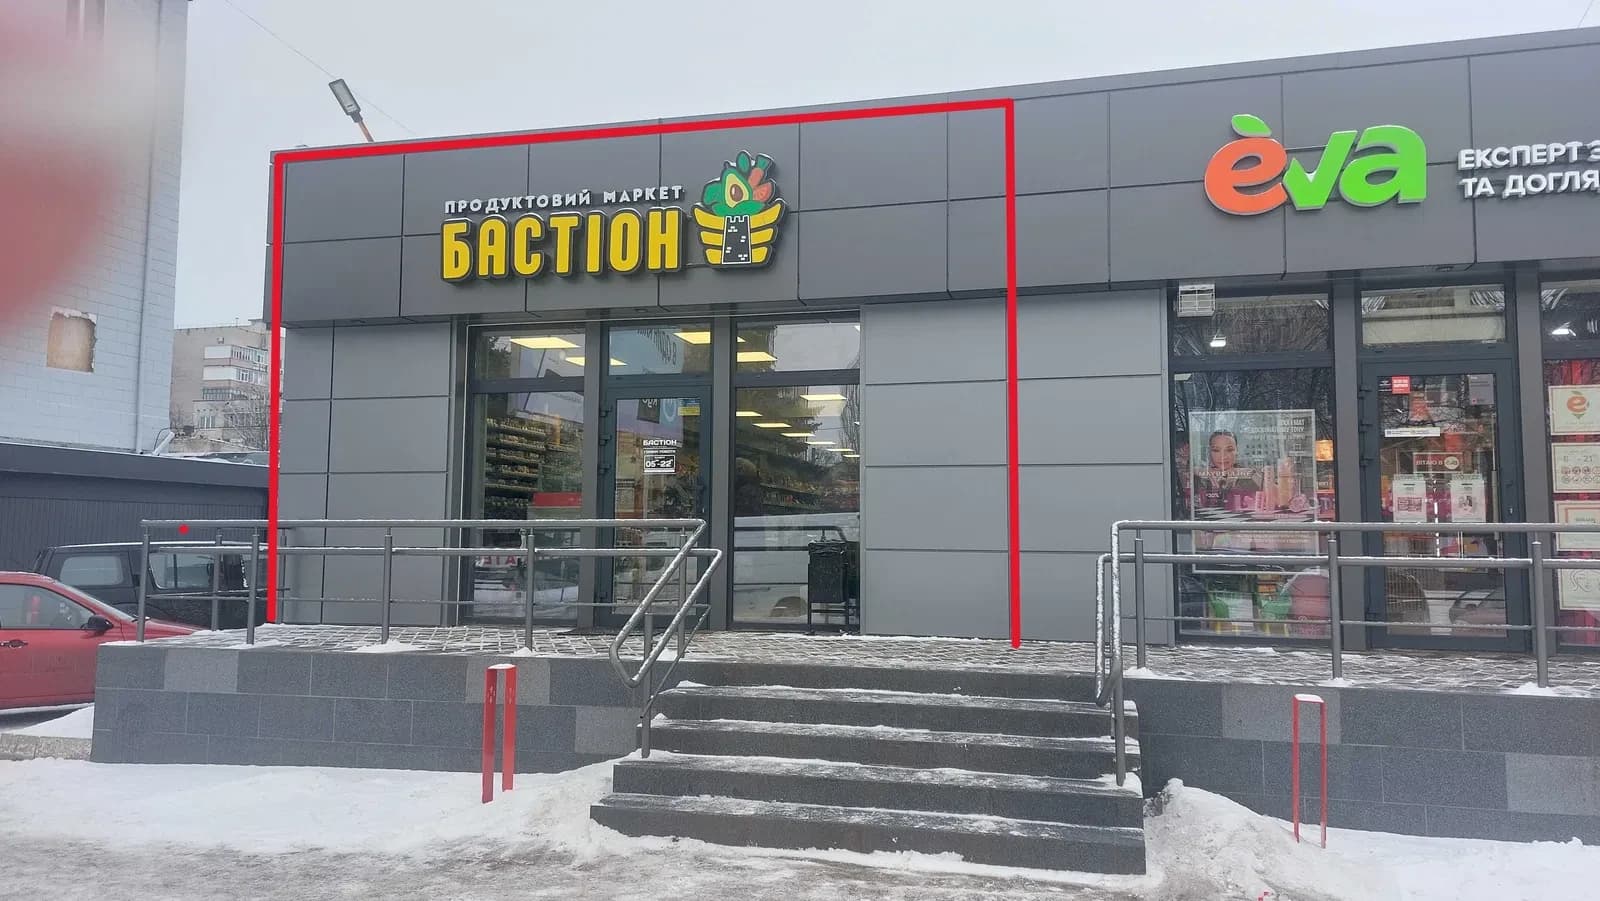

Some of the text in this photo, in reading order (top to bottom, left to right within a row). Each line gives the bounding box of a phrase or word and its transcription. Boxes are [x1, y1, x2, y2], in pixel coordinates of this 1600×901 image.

[1457, 140, 1583, 171] ЕКСПЕРТ
[1459, 169, 1600, 199] ТА ДОГЛЯ
[444, 185, 684, 214] ПРОДУКТОВИЙ МАРКЕТ
[442, 208, 683, 281] БАСТІОН
